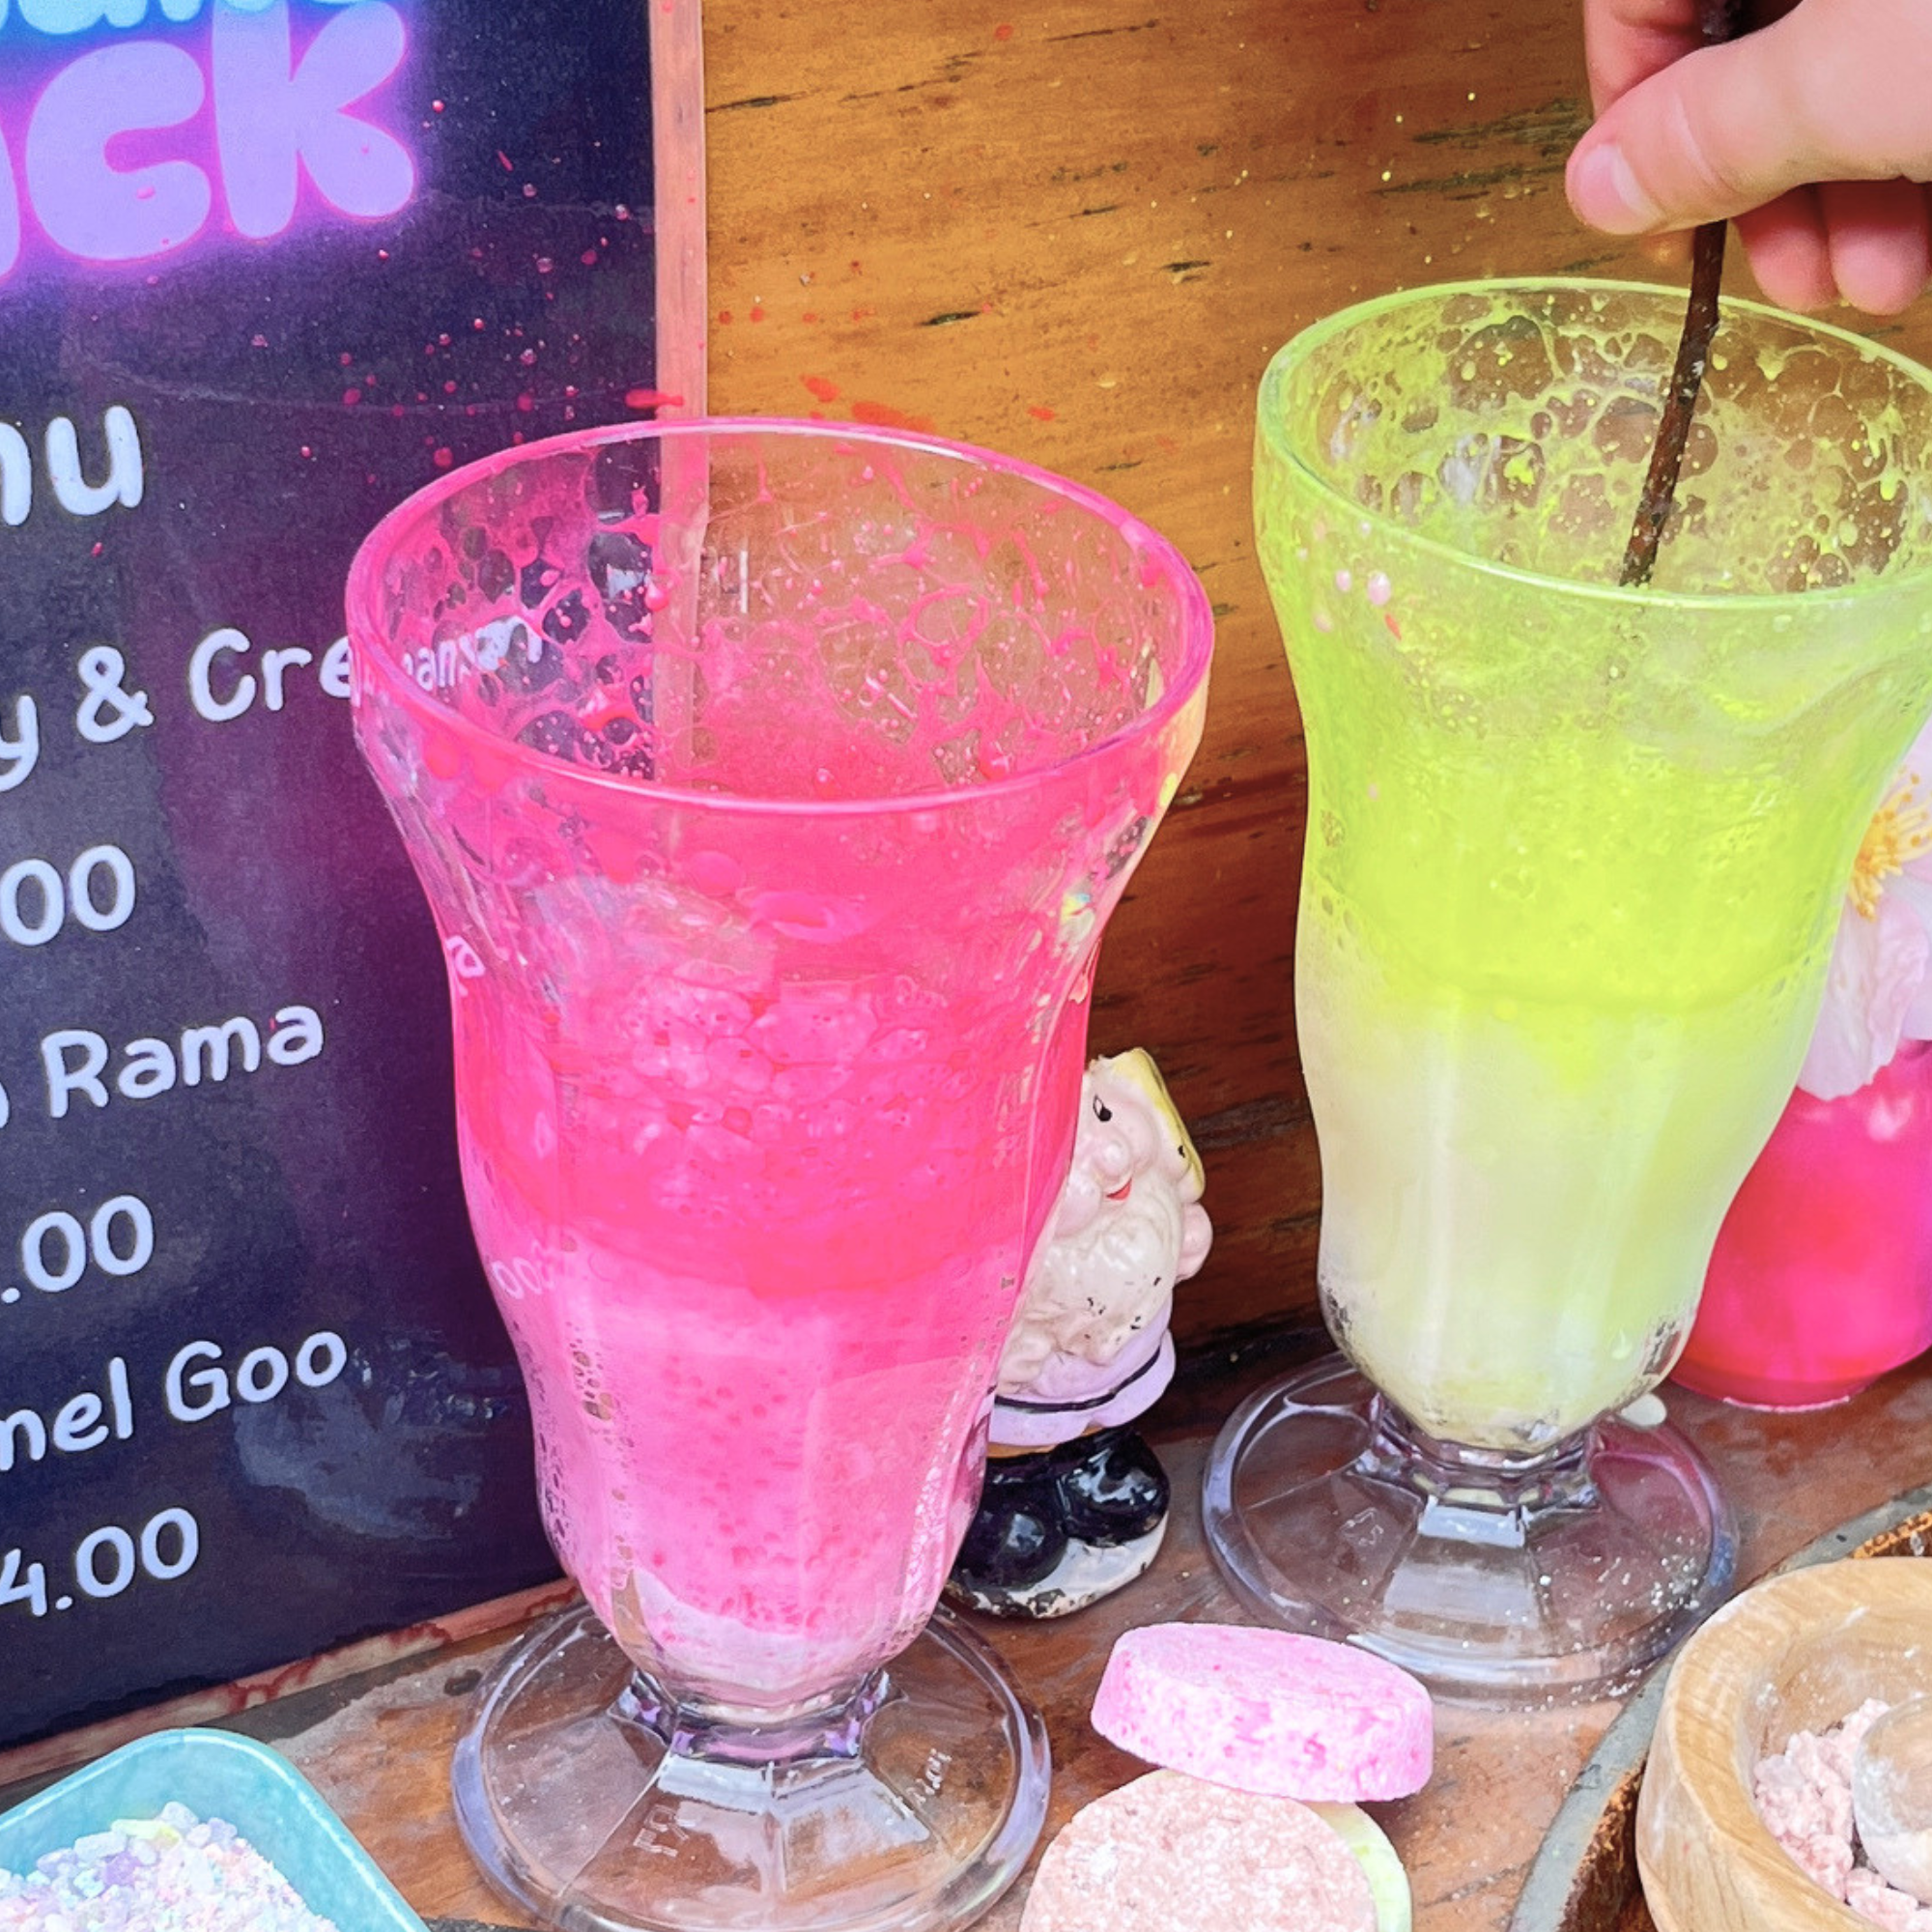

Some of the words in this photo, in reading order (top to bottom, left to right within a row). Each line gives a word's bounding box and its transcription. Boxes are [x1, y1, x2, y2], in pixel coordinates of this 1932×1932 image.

[76, 646, 155, 742] &
[41, 1006, 323, 1118] Rama
[166, 1332, 347, 1421] Goo
[0, 1508, 198, 1616] 4.00
